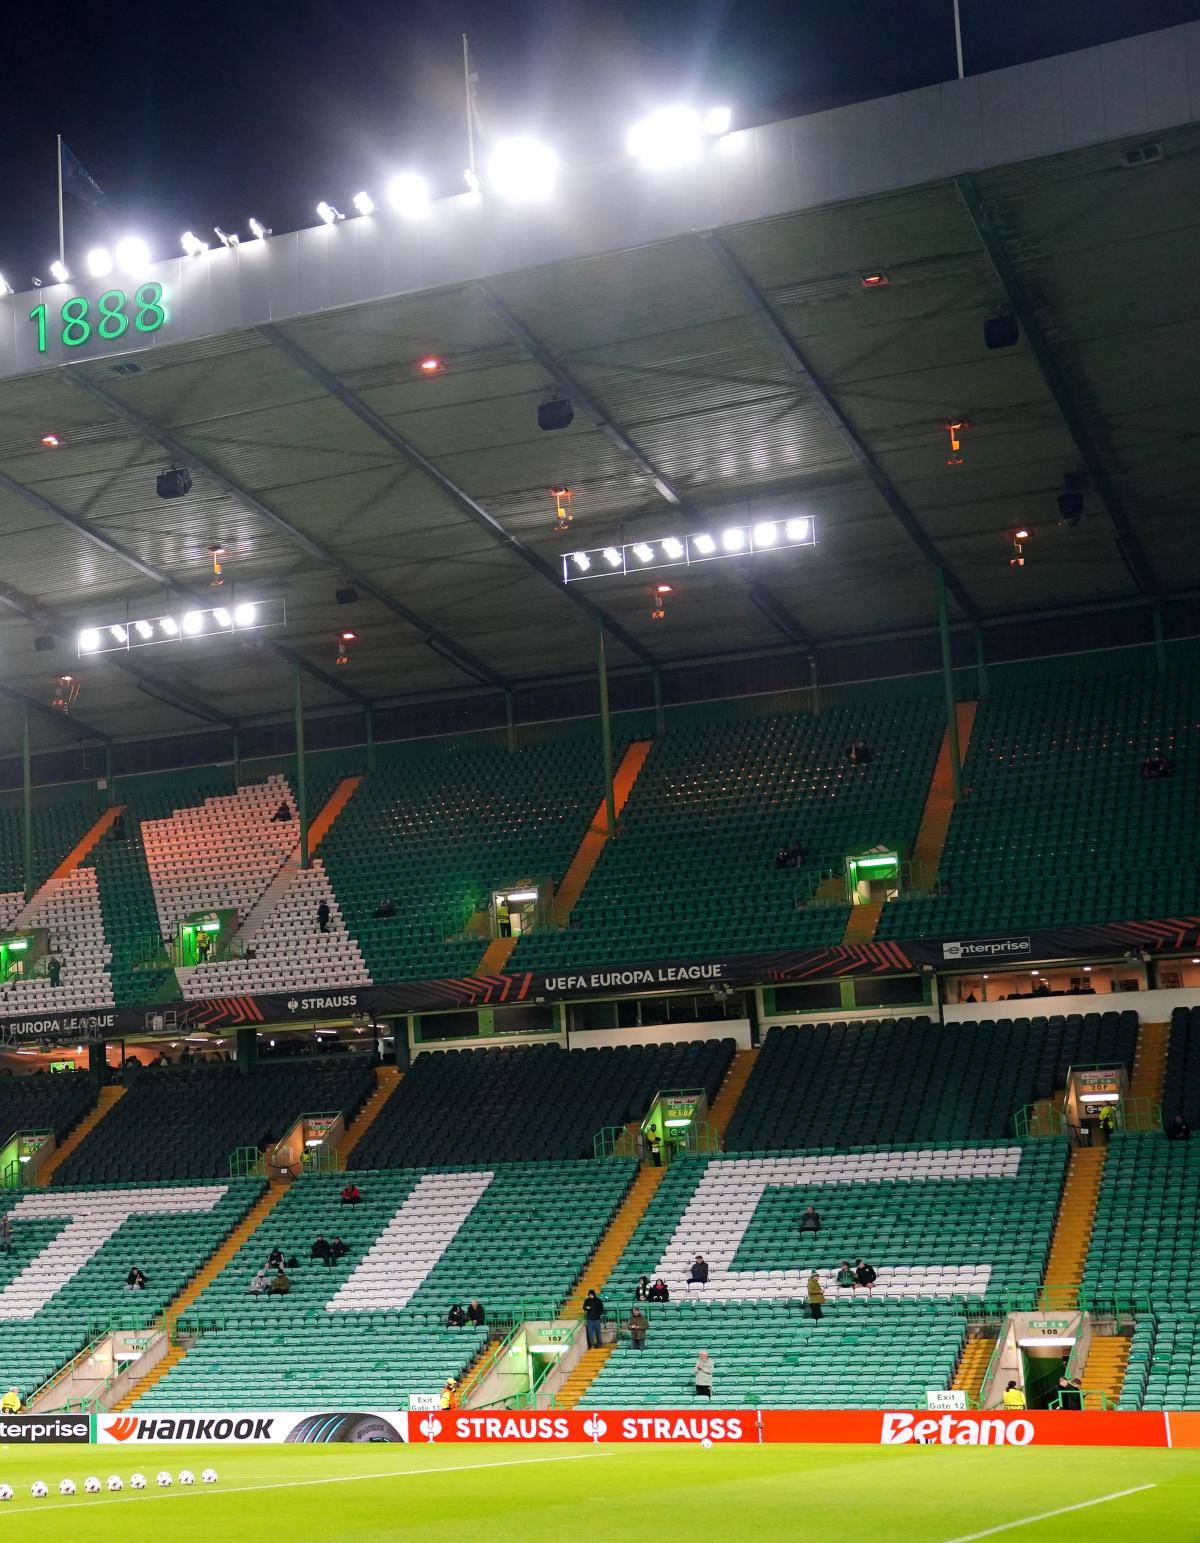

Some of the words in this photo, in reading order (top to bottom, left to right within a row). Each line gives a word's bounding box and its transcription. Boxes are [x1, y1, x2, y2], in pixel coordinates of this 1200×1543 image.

[28, 280, 167, 353] 1888
[949, 941, 1029, 955] enterprise
[545, 978, 587, 990] UEFA
[591, 970, 654, 987] EUROPA
[302, 995, 357, 1009] STRAUSS
[10, 1020, 60, 1034] EUROPA
[455, 1417, 570, 1439] STRAUSS
[622, 1417, 743, 1439] STRAUSS
[880, 1412, 1035, 1446] Betano
